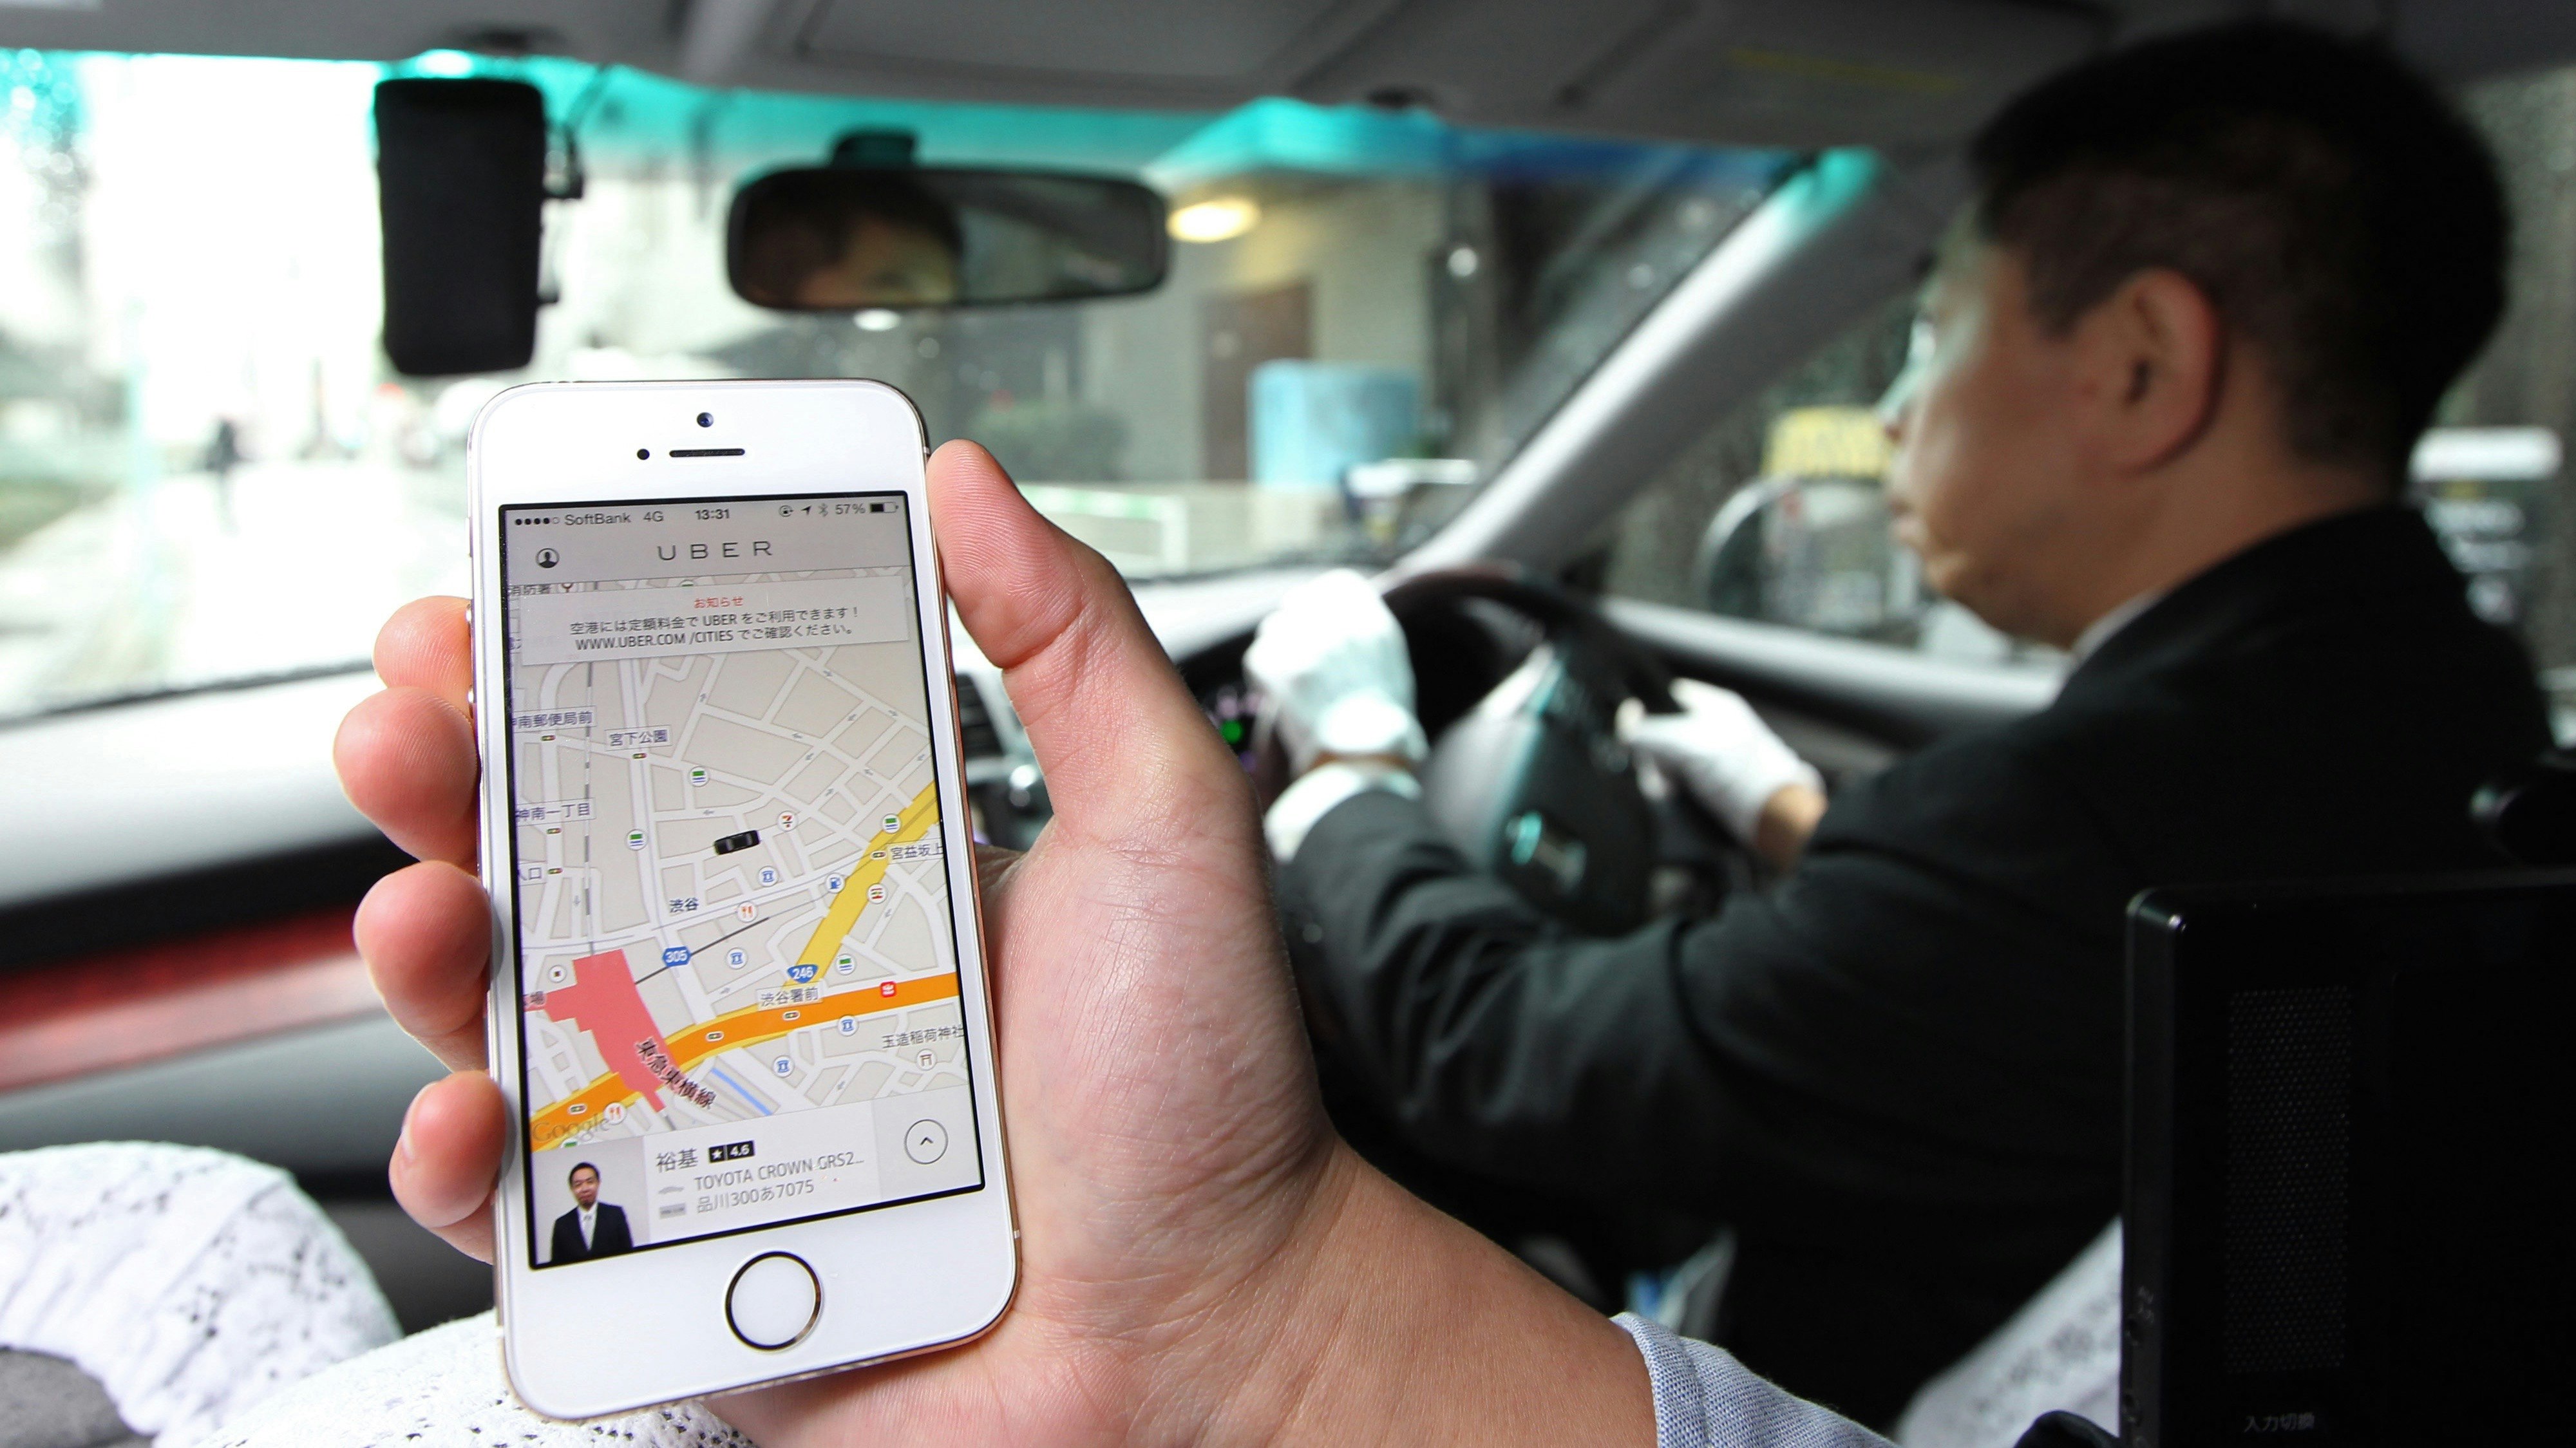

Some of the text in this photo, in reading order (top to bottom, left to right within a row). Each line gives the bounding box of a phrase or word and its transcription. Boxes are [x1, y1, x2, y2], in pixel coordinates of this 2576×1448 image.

[695, 508, 730, 520] 13:31
[835, 503, 866, 514] 57%
[565, 511, 664, 526] SoftBank 4G
[657, 541, 773, 561] UBER
[694, 596, 744, 608] お知らせ
[703, 614, 738, 627] UBER
[609, 729, 668, 747] 宮下公園
[669, 897, 699, 913] 渋谷
[665, 950, 688, 963] 305
[792, 967, 814, 980] 246
[760, 986, 819, 1006] 渋谷署前
[637, 1037, 717, 1109] 東急東横線
[532, 1113, 611, 1142] Google
[729, 1144, 750, 1156] 4.6
[656, 1148, 698, 1173] 裕基
[694, 1168, 754, 1191] TOYOTA
[757, 1158, 813, 1181] CROWN
